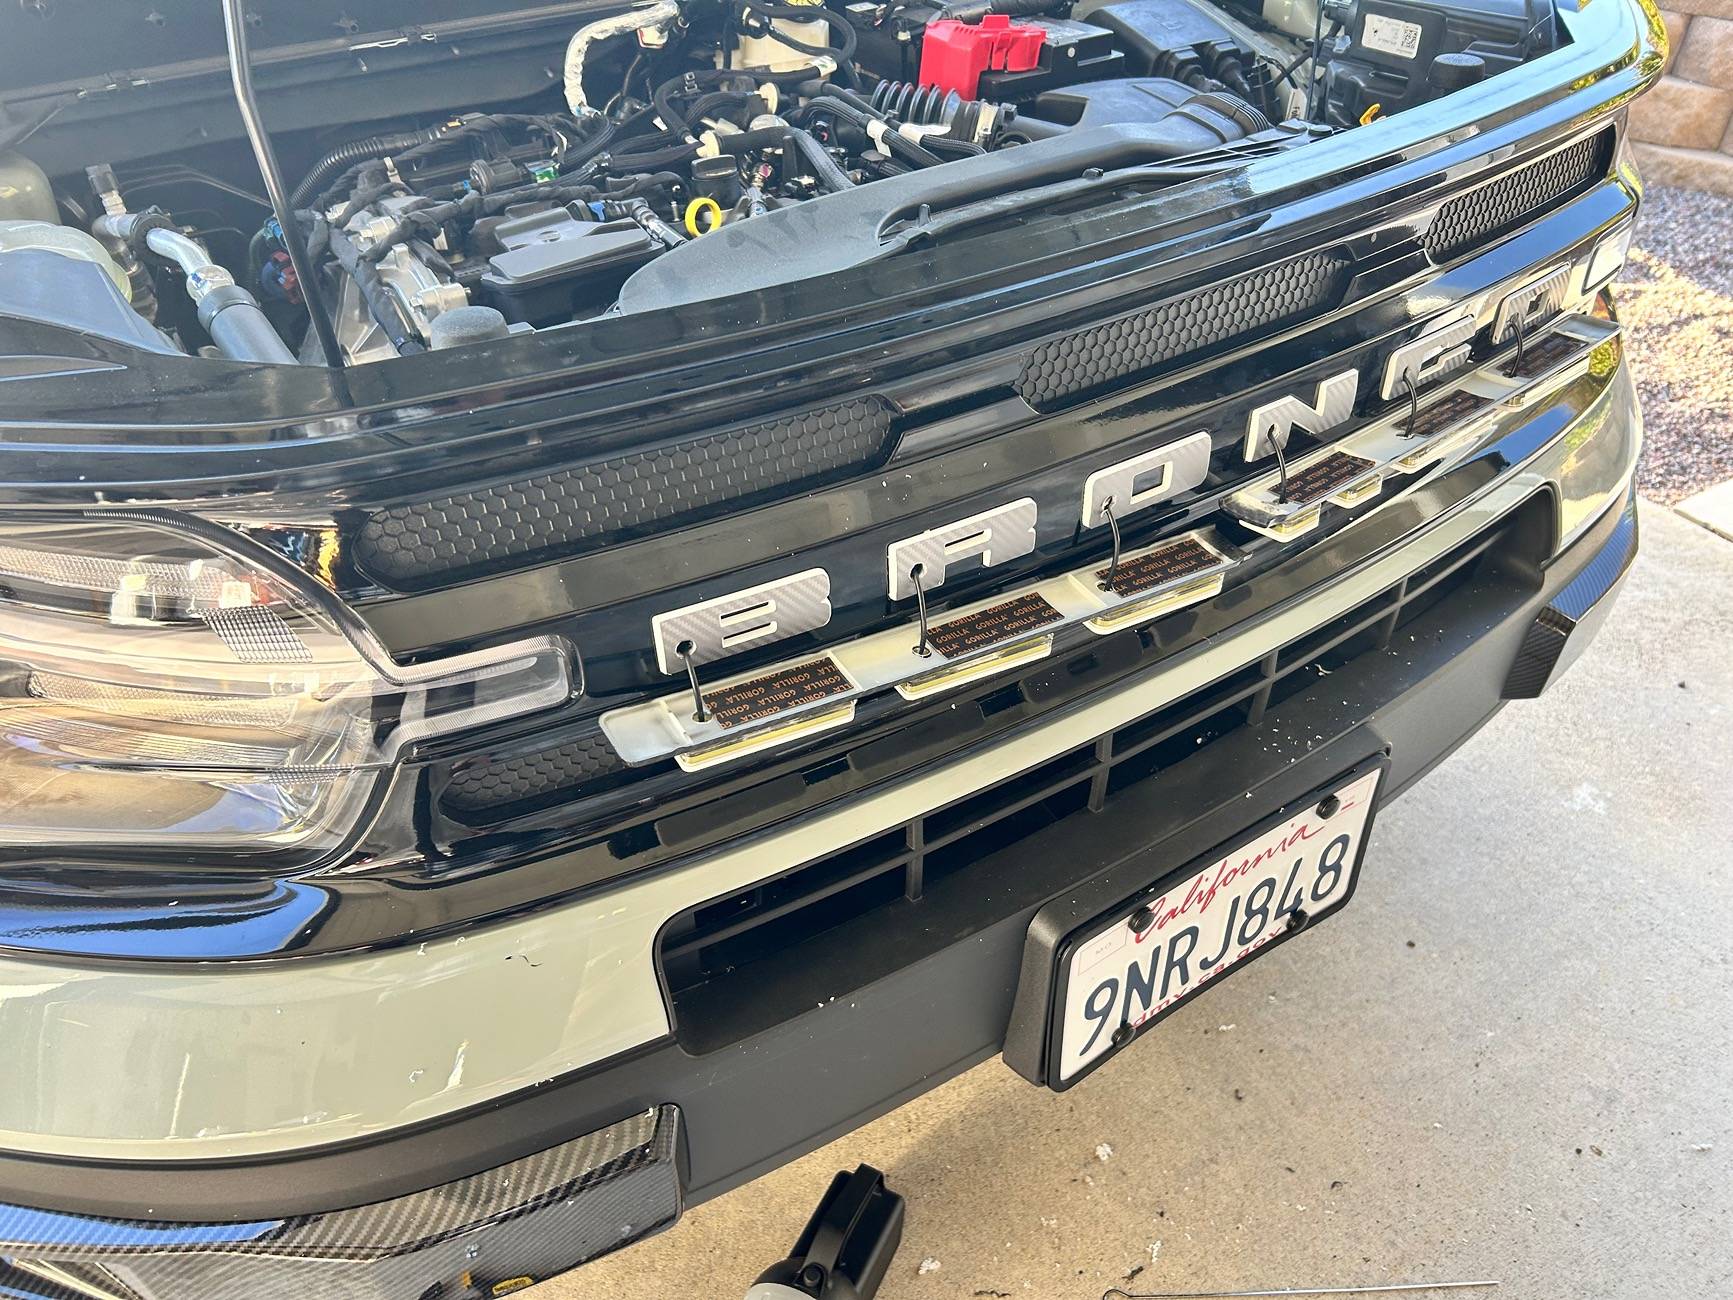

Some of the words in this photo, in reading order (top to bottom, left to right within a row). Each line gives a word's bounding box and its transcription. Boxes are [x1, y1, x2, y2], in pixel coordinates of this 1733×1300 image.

[652, 262, 1571, 675] BRONCO
[936, 628, 968, 644] GORILLA
[976, 615, 1008, 630] GORILLA
[1014, 602, 1045, 616] GORILLA
[965, 630, 998, 644] GORILLA
[1004, 616, 1036, 630] GORILLA
[773, 673, 810, 689] GORILLA
[804, 675, 840, 691] GORILLA
[726, 687, 765, 703] GORILLA
[758, 690, 796, 706] GORILLA
[788, 691, 826, 706] GORILLA
[741, 706, 780, 722] GORILLA
[1135, 823, 1325, 944] California
[1079, 834, 1350, 1056] 9NRJ848
